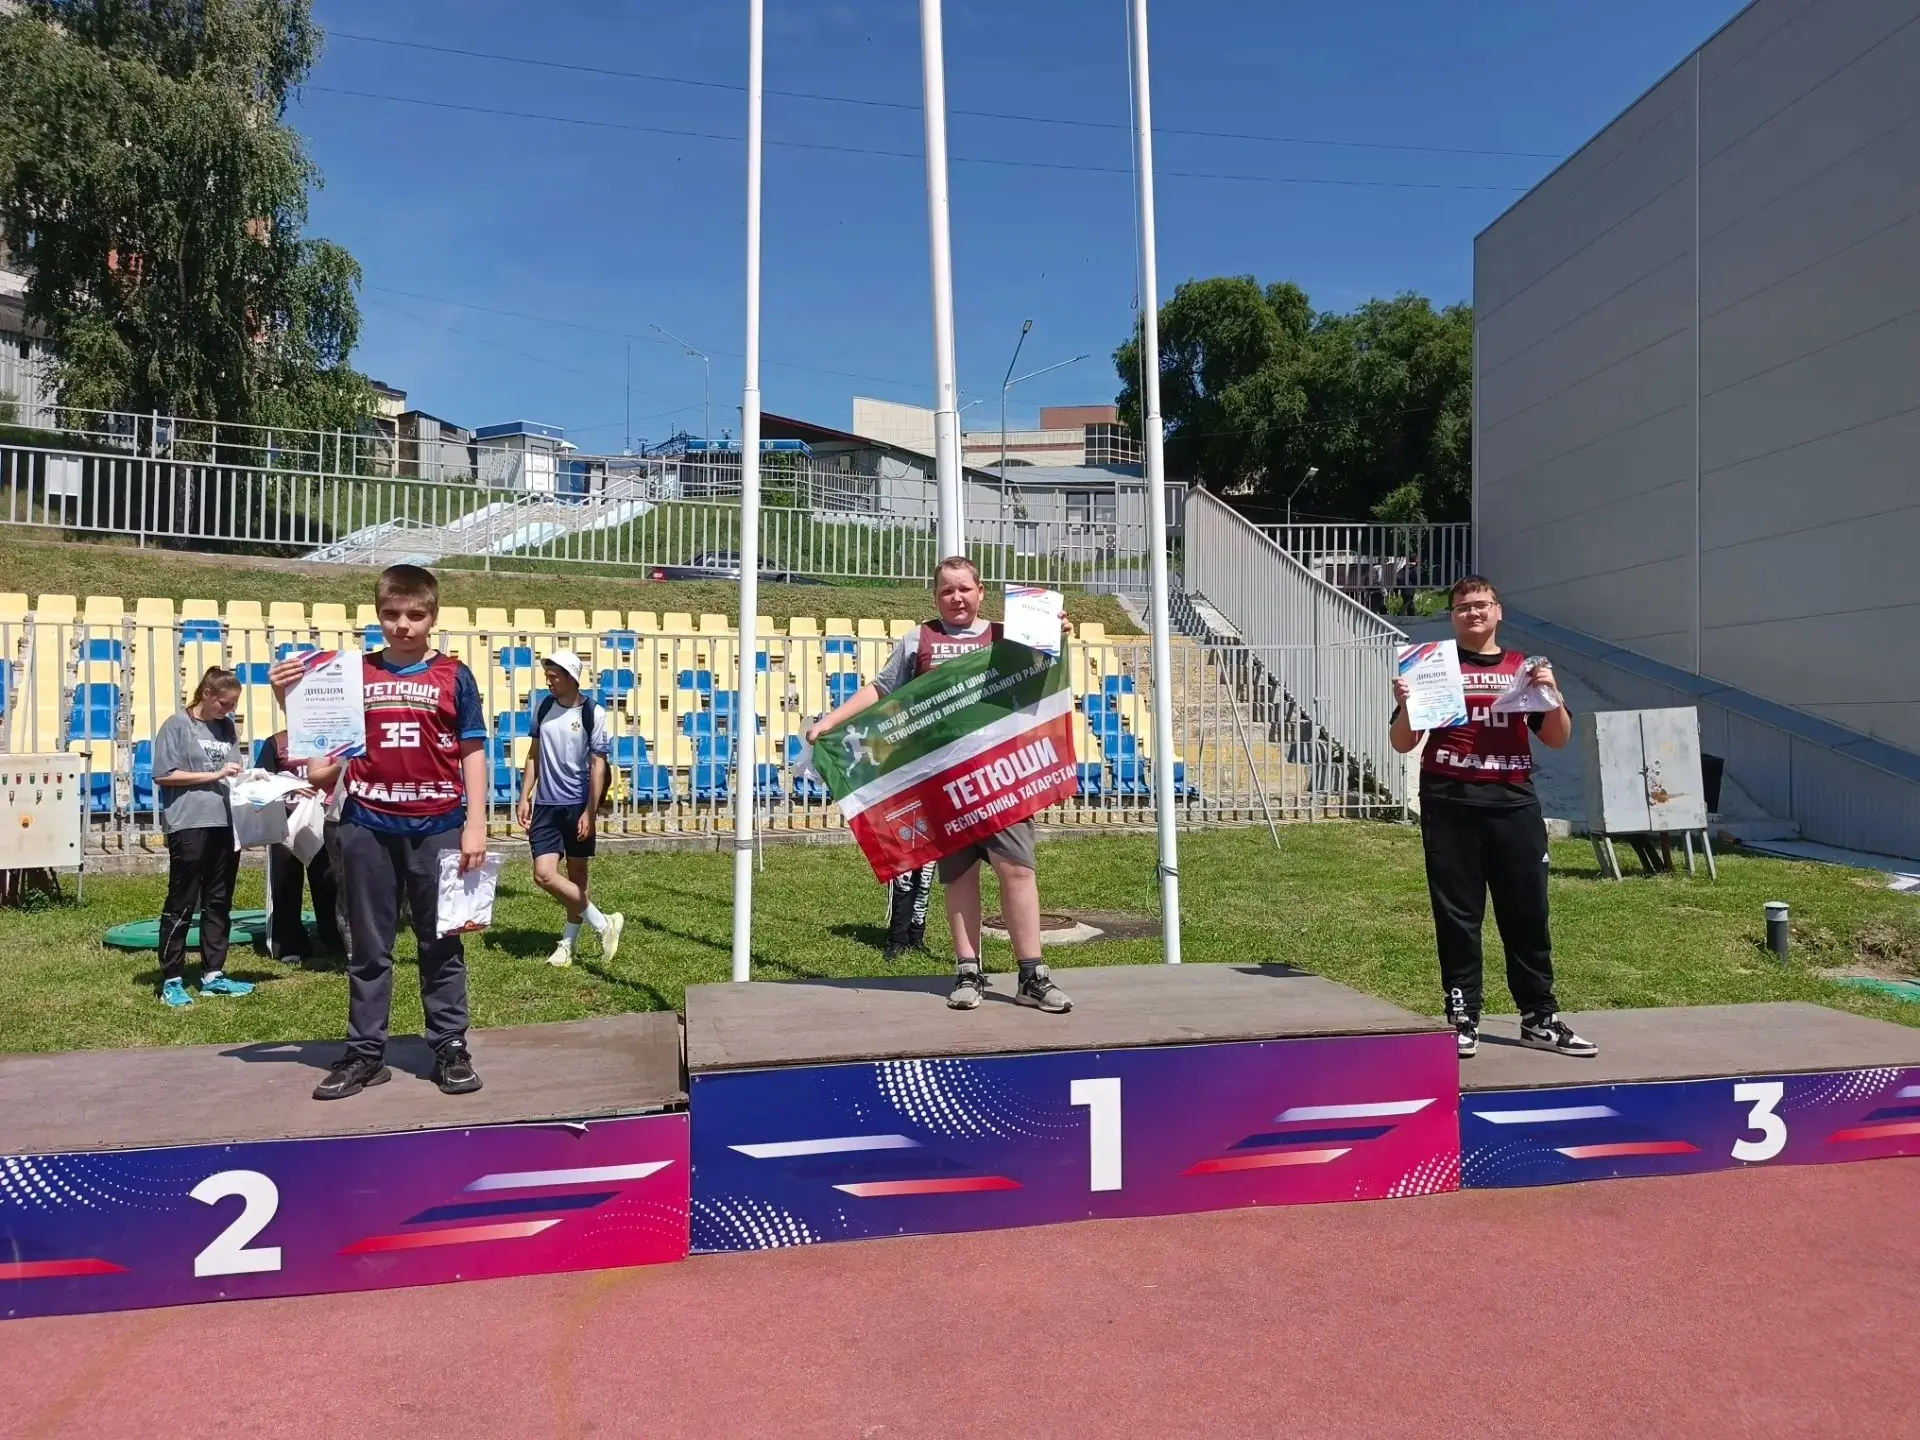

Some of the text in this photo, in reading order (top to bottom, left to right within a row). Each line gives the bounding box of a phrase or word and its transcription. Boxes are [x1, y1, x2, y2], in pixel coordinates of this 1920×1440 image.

[931, 643, 984, 654] ТЕТЮ
[304, 688, 344, 696] ДИПЛОМ
[364, 681, 440, 699] ТЕТЮШИ
[1416, 671, 1447, 681] ДИПЛОМ
[1461, 672, 1514, 685] ЕТЮШ
[877, 667, 1000, 733] МБУДО СПОРТИВНАЯ ШКОЛА
[884, 710, 942, 745] ТЕТЮШСКОГО
[942, 672, 1022, 717] МУНИЦИПАЛЬНОГО
[1471, 706, 1509, 727] 40
[380, 722, 420, 748] 35
[942, 736, 1059, 810] ТЕТЮШИ
[944, 792, 1020, 837] РЕСПУБЛИКА
[1070, 1077, 1122, 1192] 1
[1730, 1081, 1788, 1162] 3
[189, 1168, 282, 1278] 2
